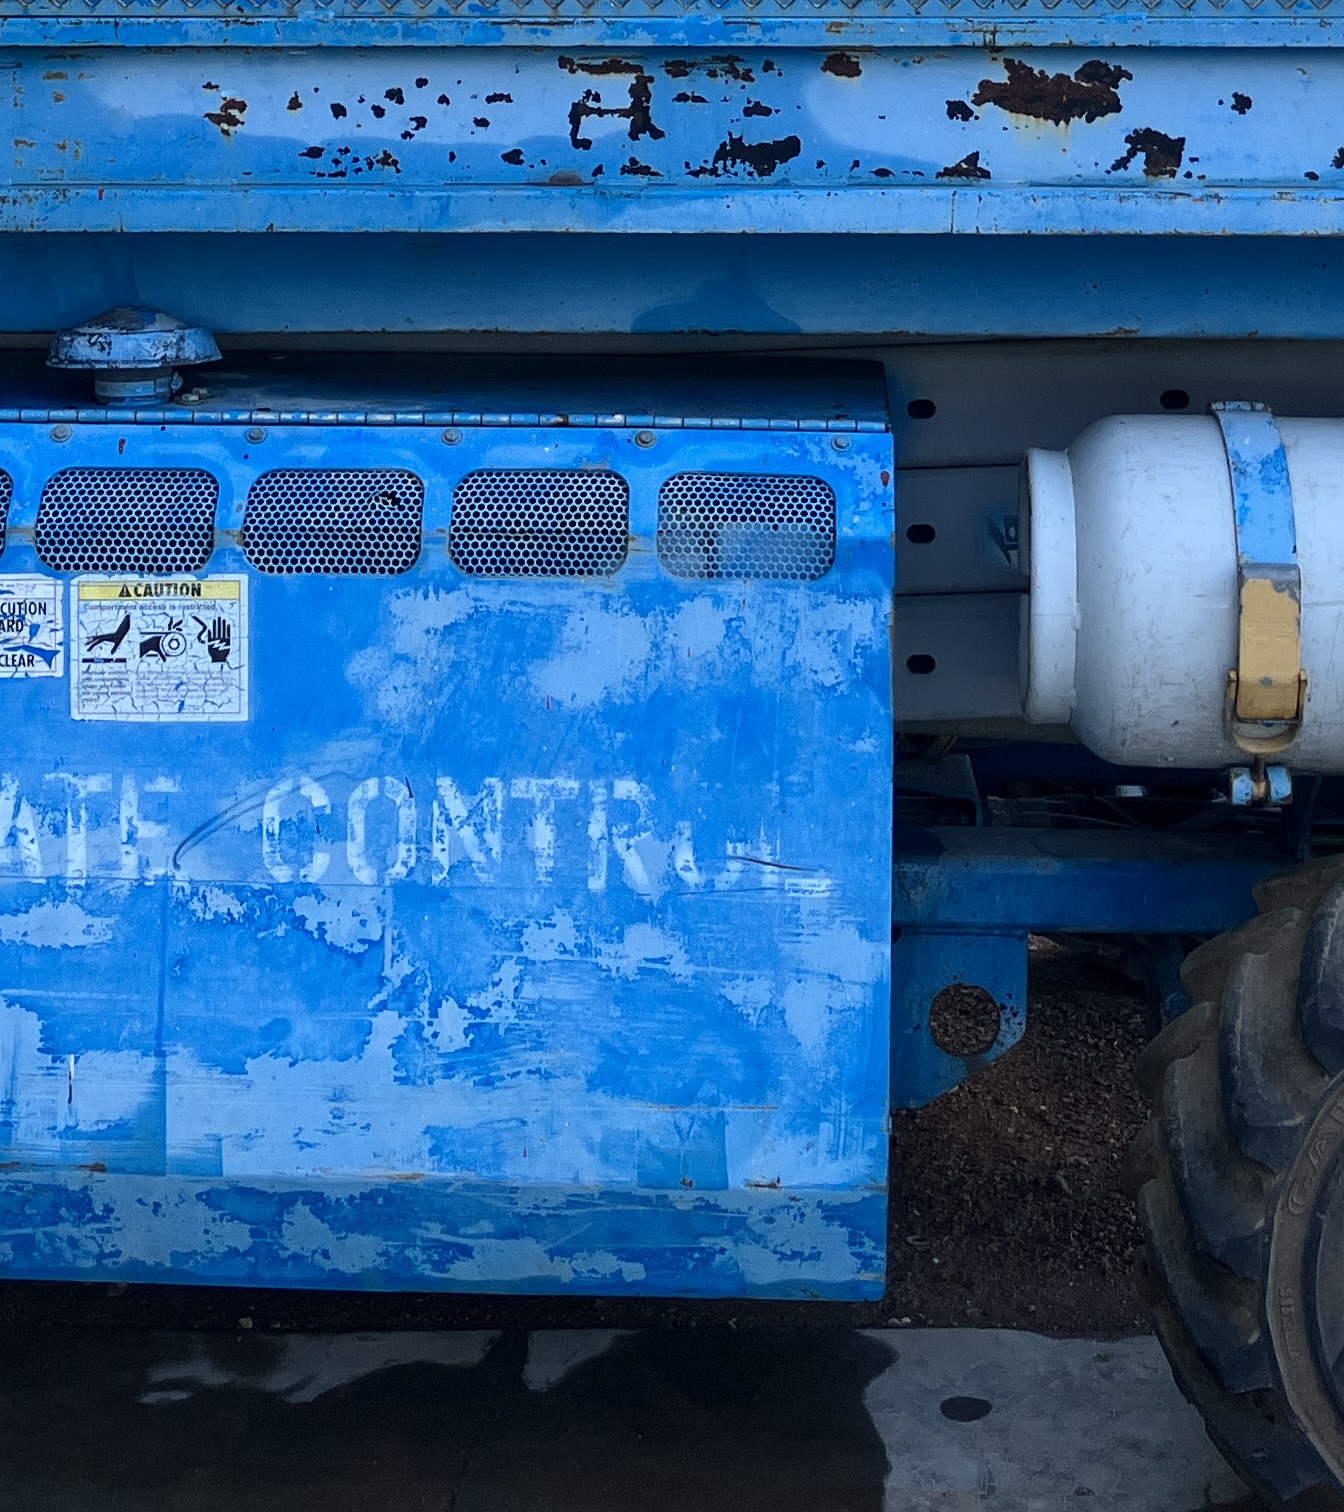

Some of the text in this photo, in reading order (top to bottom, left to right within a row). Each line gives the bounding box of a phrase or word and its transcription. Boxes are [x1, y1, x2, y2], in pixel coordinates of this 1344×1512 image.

[133, 582, 202, 597] CAUTION
[83, 603, 137, 614] Compartment
[139, 603, 167, 611] access
[169, 602, 176, 611] is
